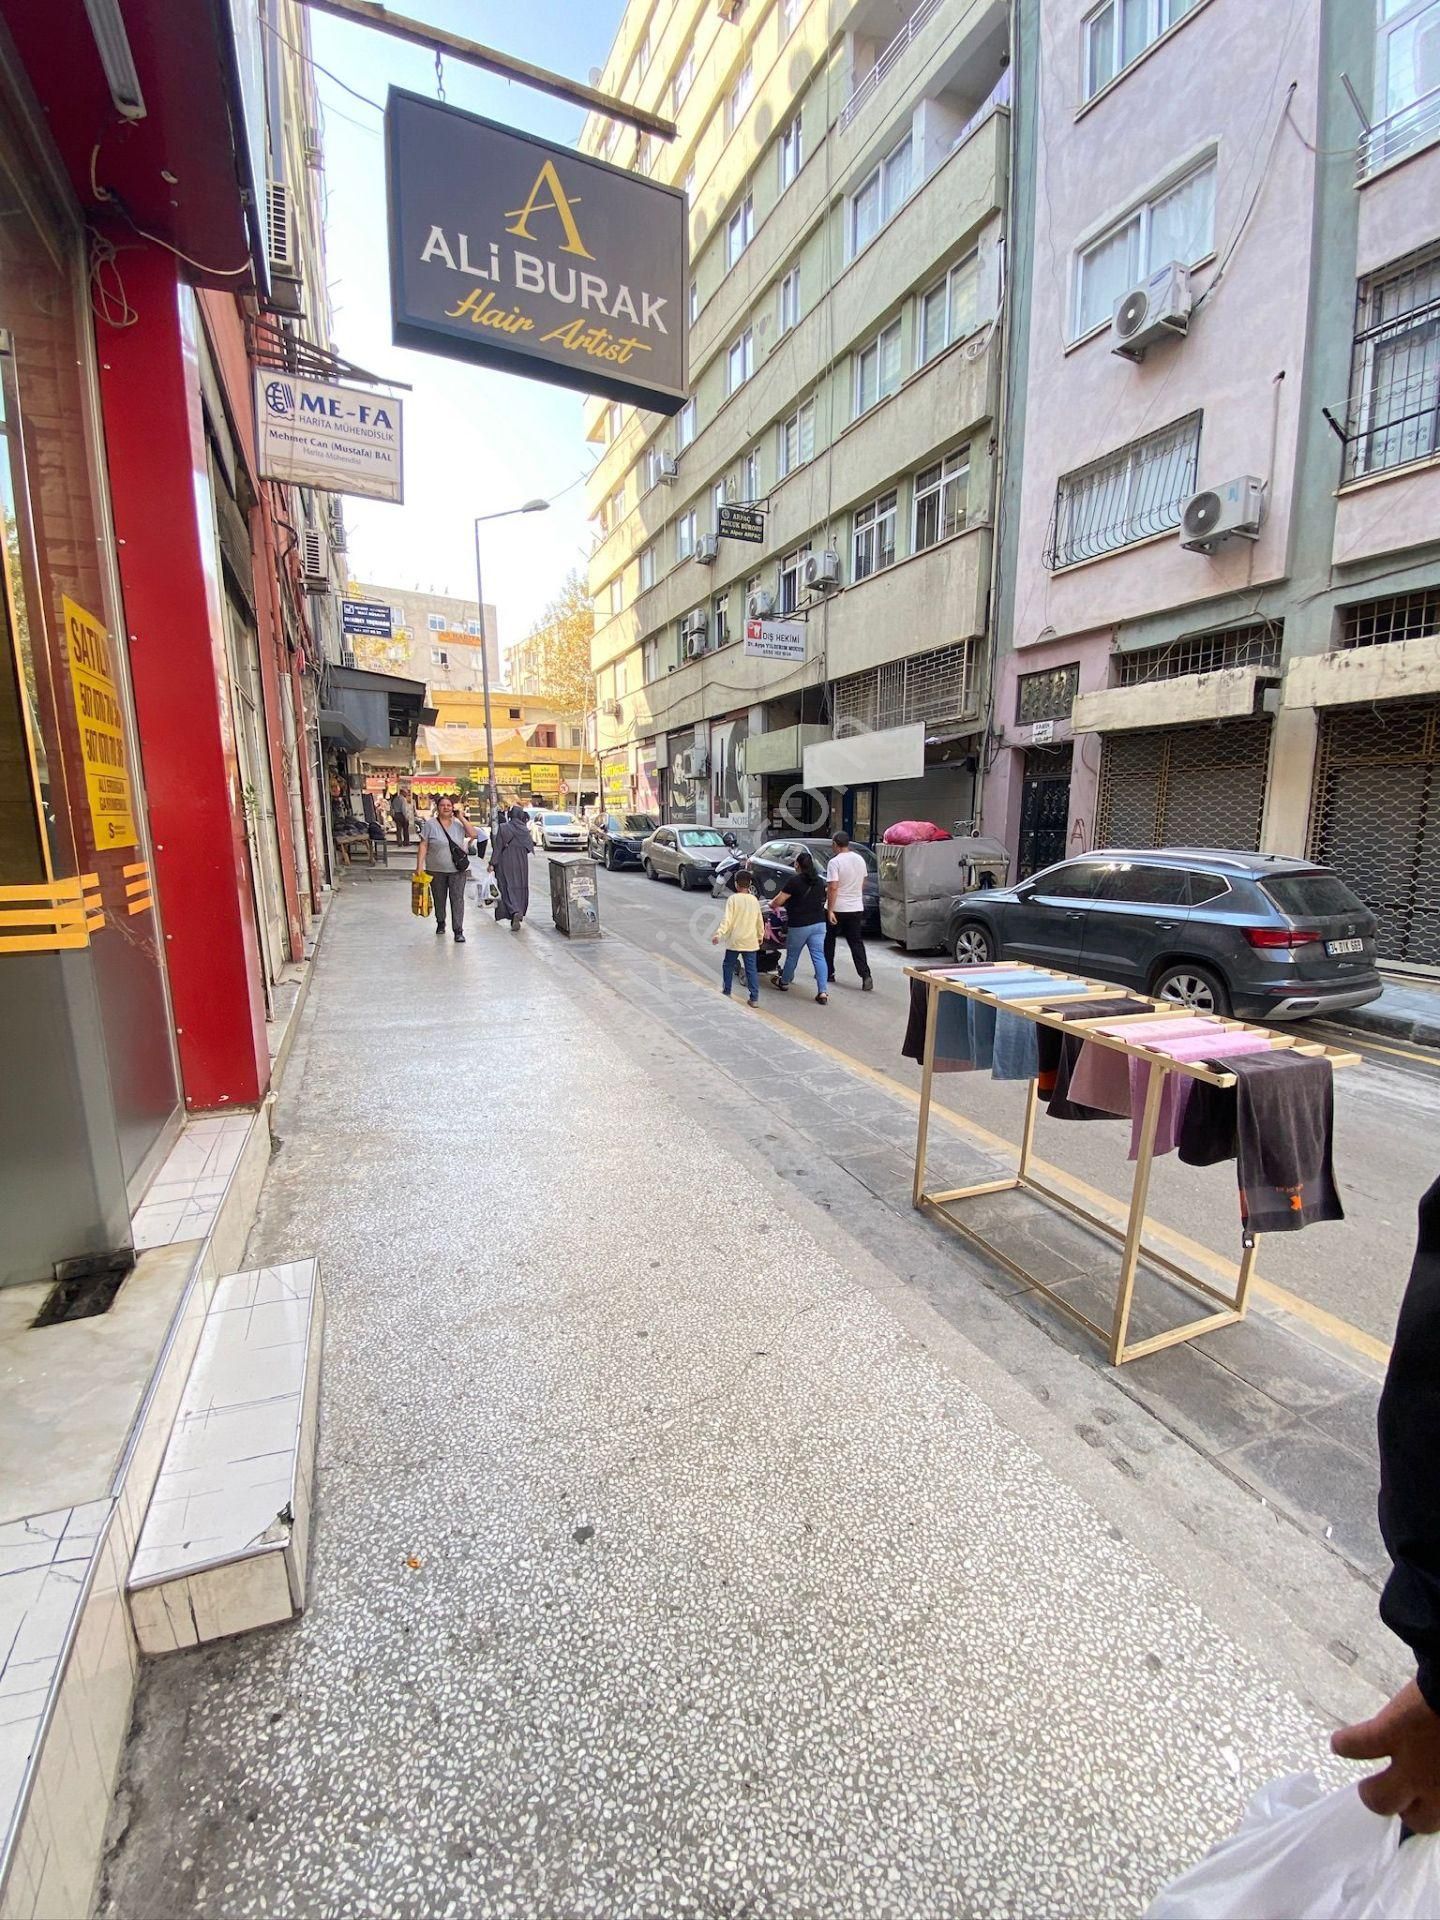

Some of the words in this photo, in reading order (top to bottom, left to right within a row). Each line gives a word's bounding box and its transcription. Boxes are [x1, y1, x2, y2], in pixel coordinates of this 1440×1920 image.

[514, 250, 669, 335] BURAK
[444, 288, 535, 334] Hair
[539, 319, 652, 364] Artist
[300, 392, 393, 430] ME-FA
[269, 429, 308, 444] Mehmet
[310, 437, 329, 449] Can
[375, 450, 393, 462] BAL
[71, 616, 112, 680] SATIL
